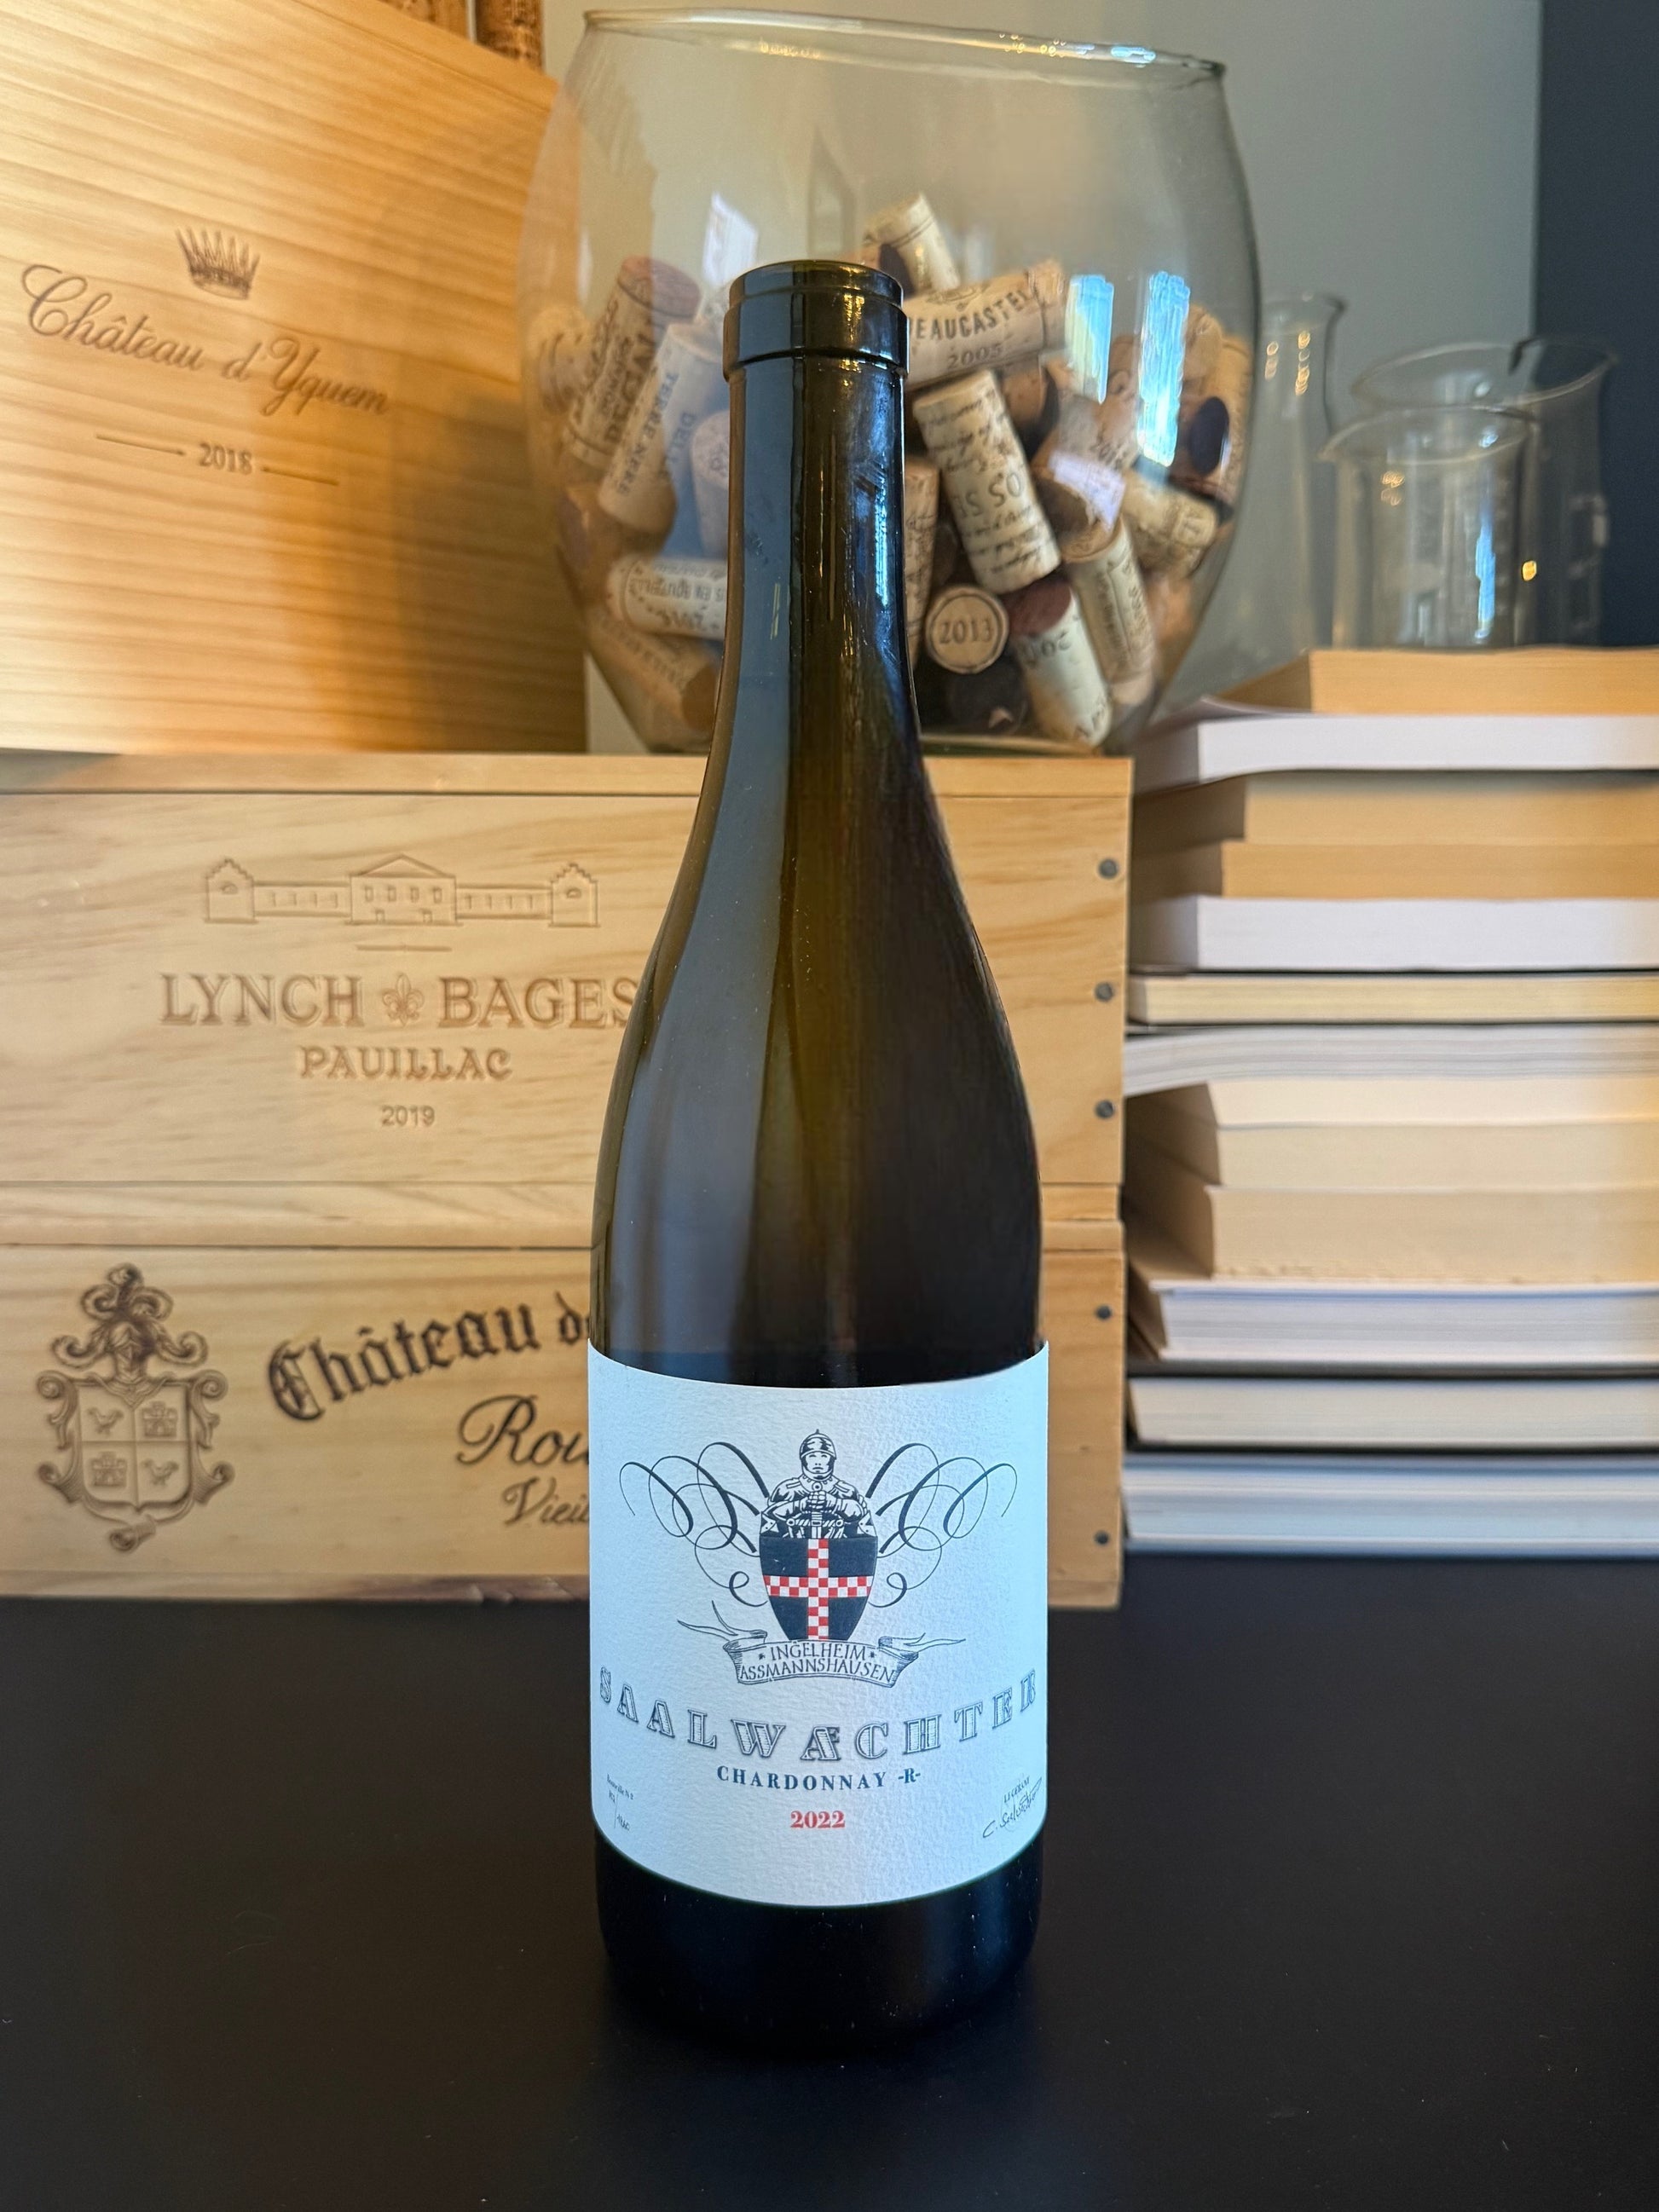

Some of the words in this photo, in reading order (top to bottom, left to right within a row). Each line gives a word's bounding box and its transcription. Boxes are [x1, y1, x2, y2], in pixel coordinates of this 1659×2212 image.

[22, 264, 204, 372] Château
[199, 442, 254, 476] 2018
[939, 617, 994, 645] 2013
[159, 973, 365, 1026] LYNCH
[437, 977, 639, 1029] BAGES
[299, 1045, 513, 1082] PAUILLAC
[380, 1106, 436, 1128] 2019
[268, 1302, 540, 1423] Château
[771, 1642, 866, 1660] INGELHEIM
[740, 1659, 895, 1683] ASSMANNSHAUSEN
[716, 1765, 887, 1791] CHARDONNAY
[789, 1810, 847, 1829] 2022
